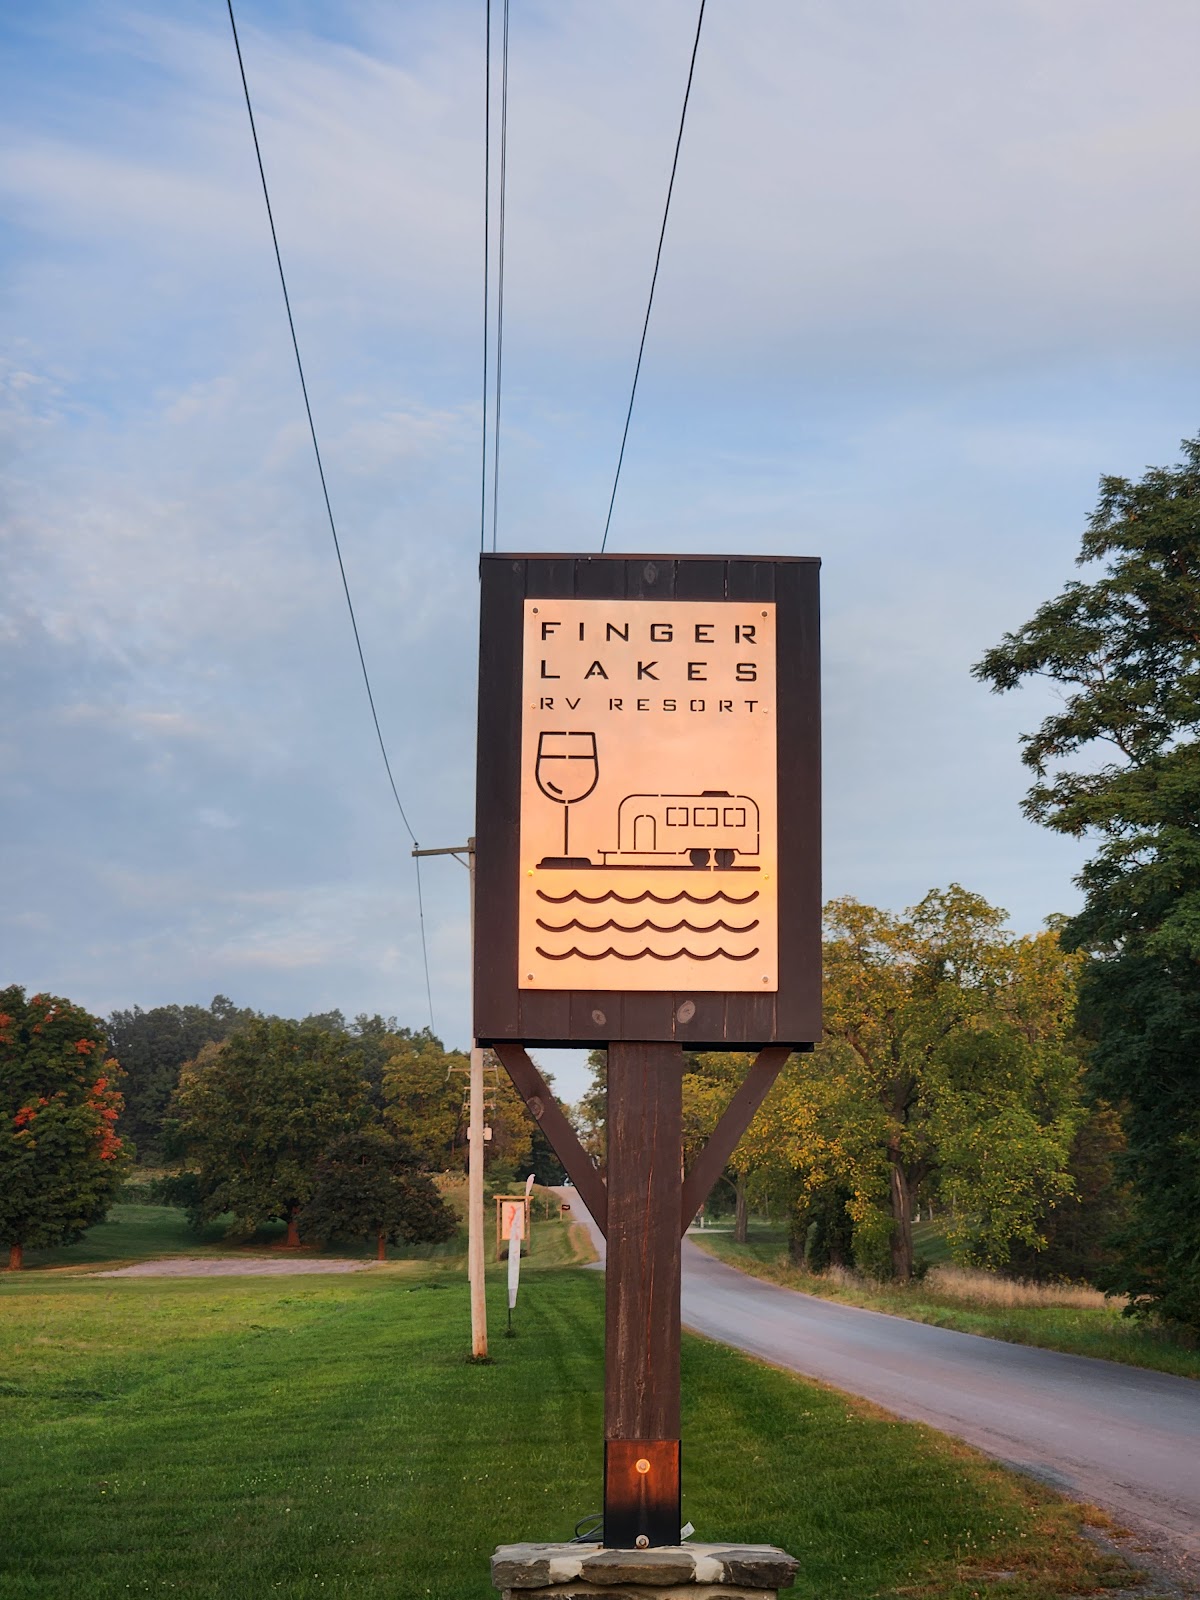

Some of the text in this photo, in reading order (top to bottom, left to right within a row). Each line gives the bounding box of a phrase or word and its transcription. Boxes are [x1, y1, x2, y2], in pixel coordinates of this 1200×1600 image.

[541, 622, 757, 644] FINGER
[540, 659, 757, 682] LAKES
[540, 697, 759, 713] RV RESORT
